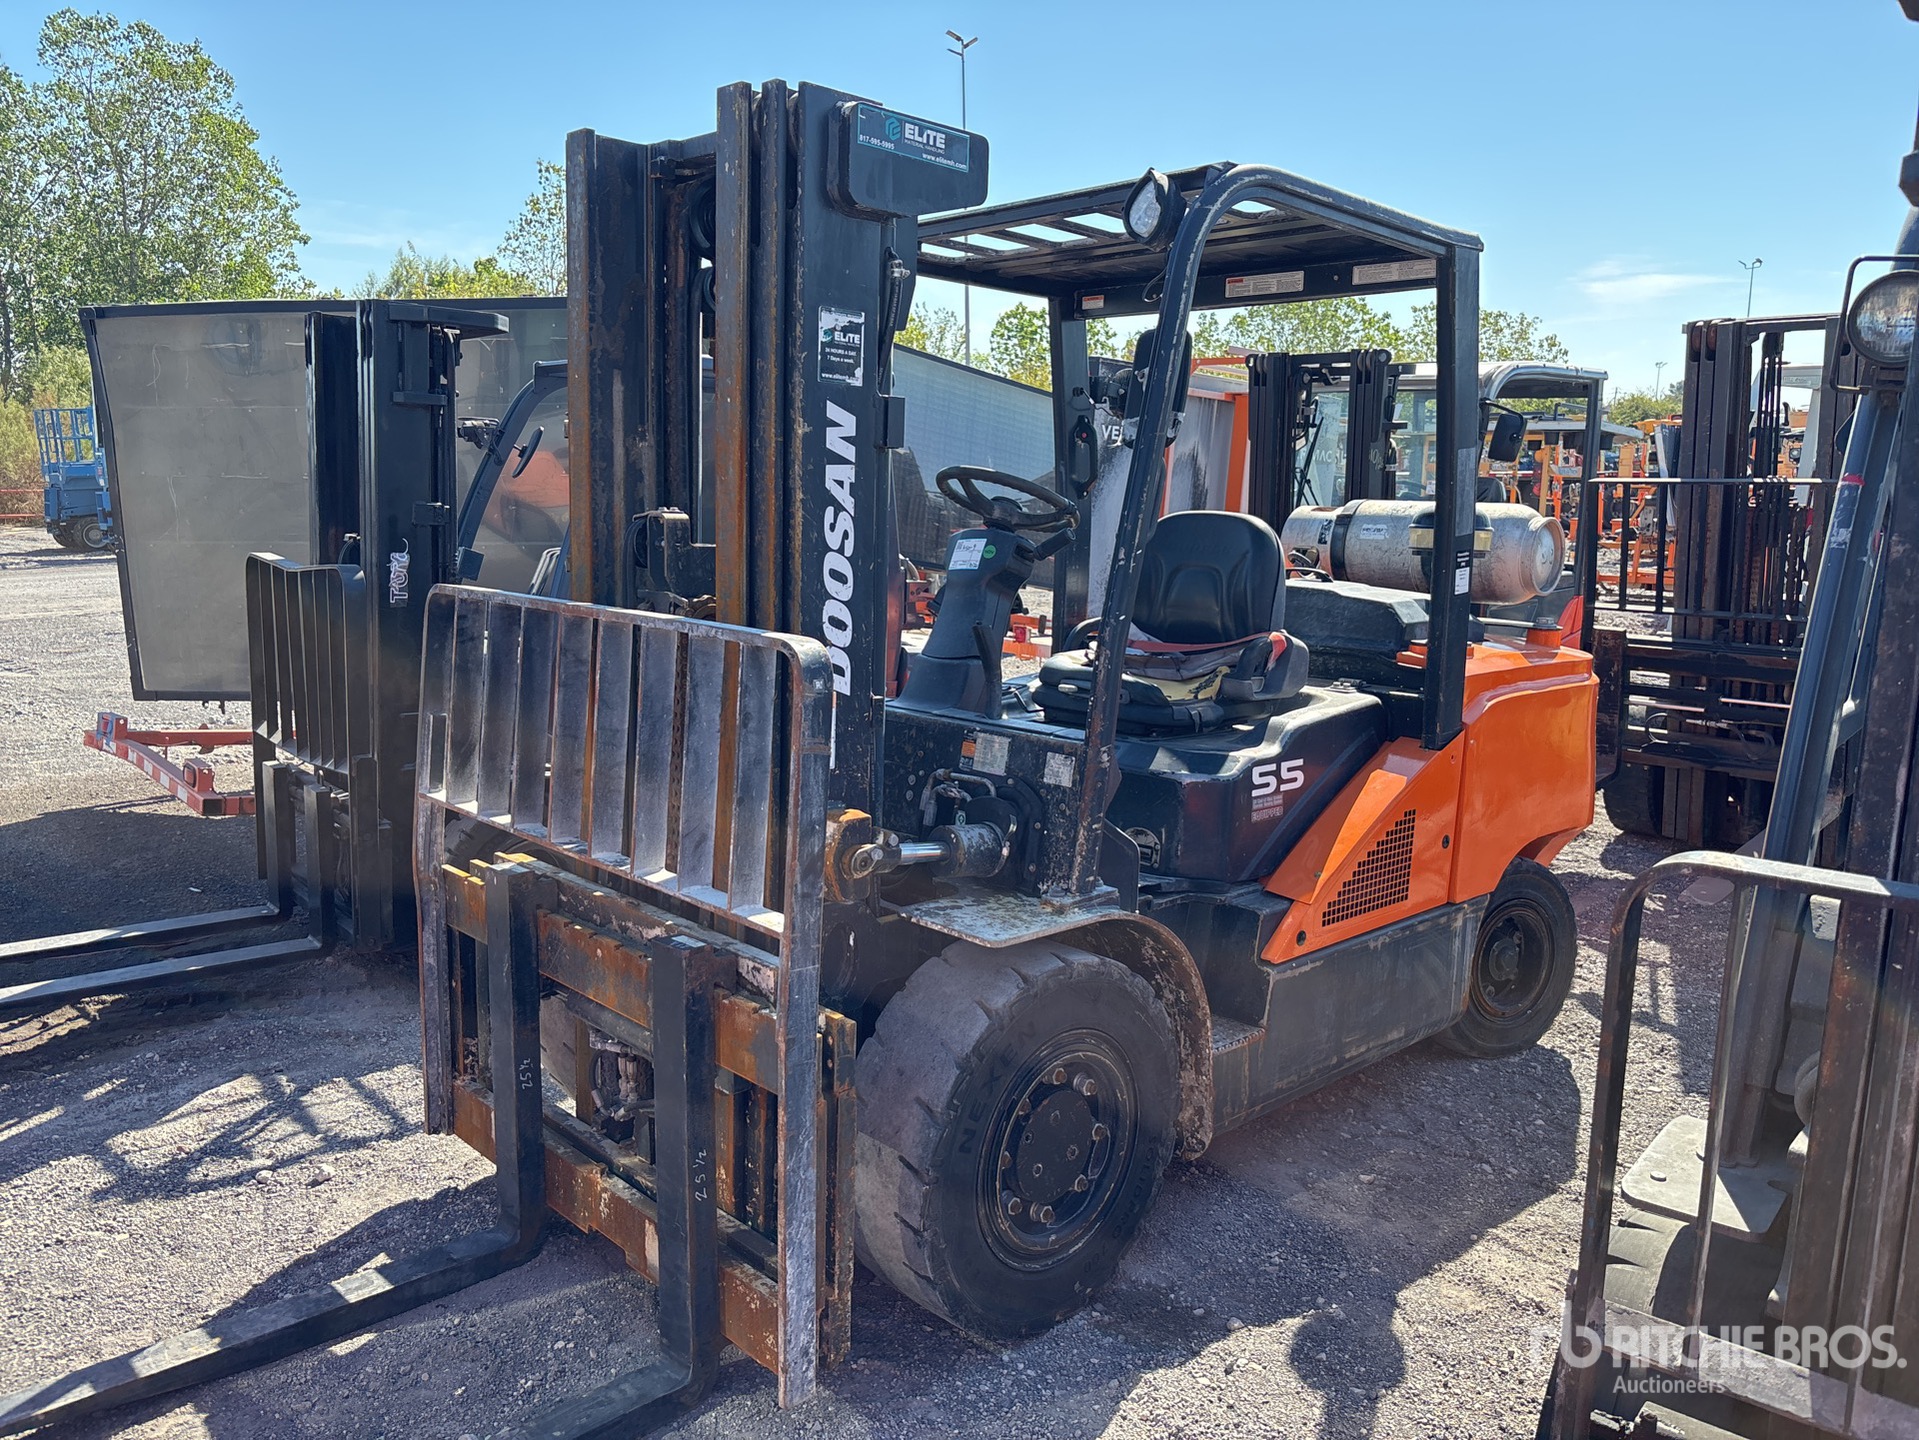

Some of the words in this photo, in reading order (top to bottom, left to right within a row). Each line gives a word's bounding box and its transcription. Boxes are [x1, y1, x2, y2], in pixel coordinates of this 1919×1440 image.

[904, 122, 946, 149] ELITE
[834, 331, 861, 344] ELITE
[823, 400, 857, 696] DOOSAN
